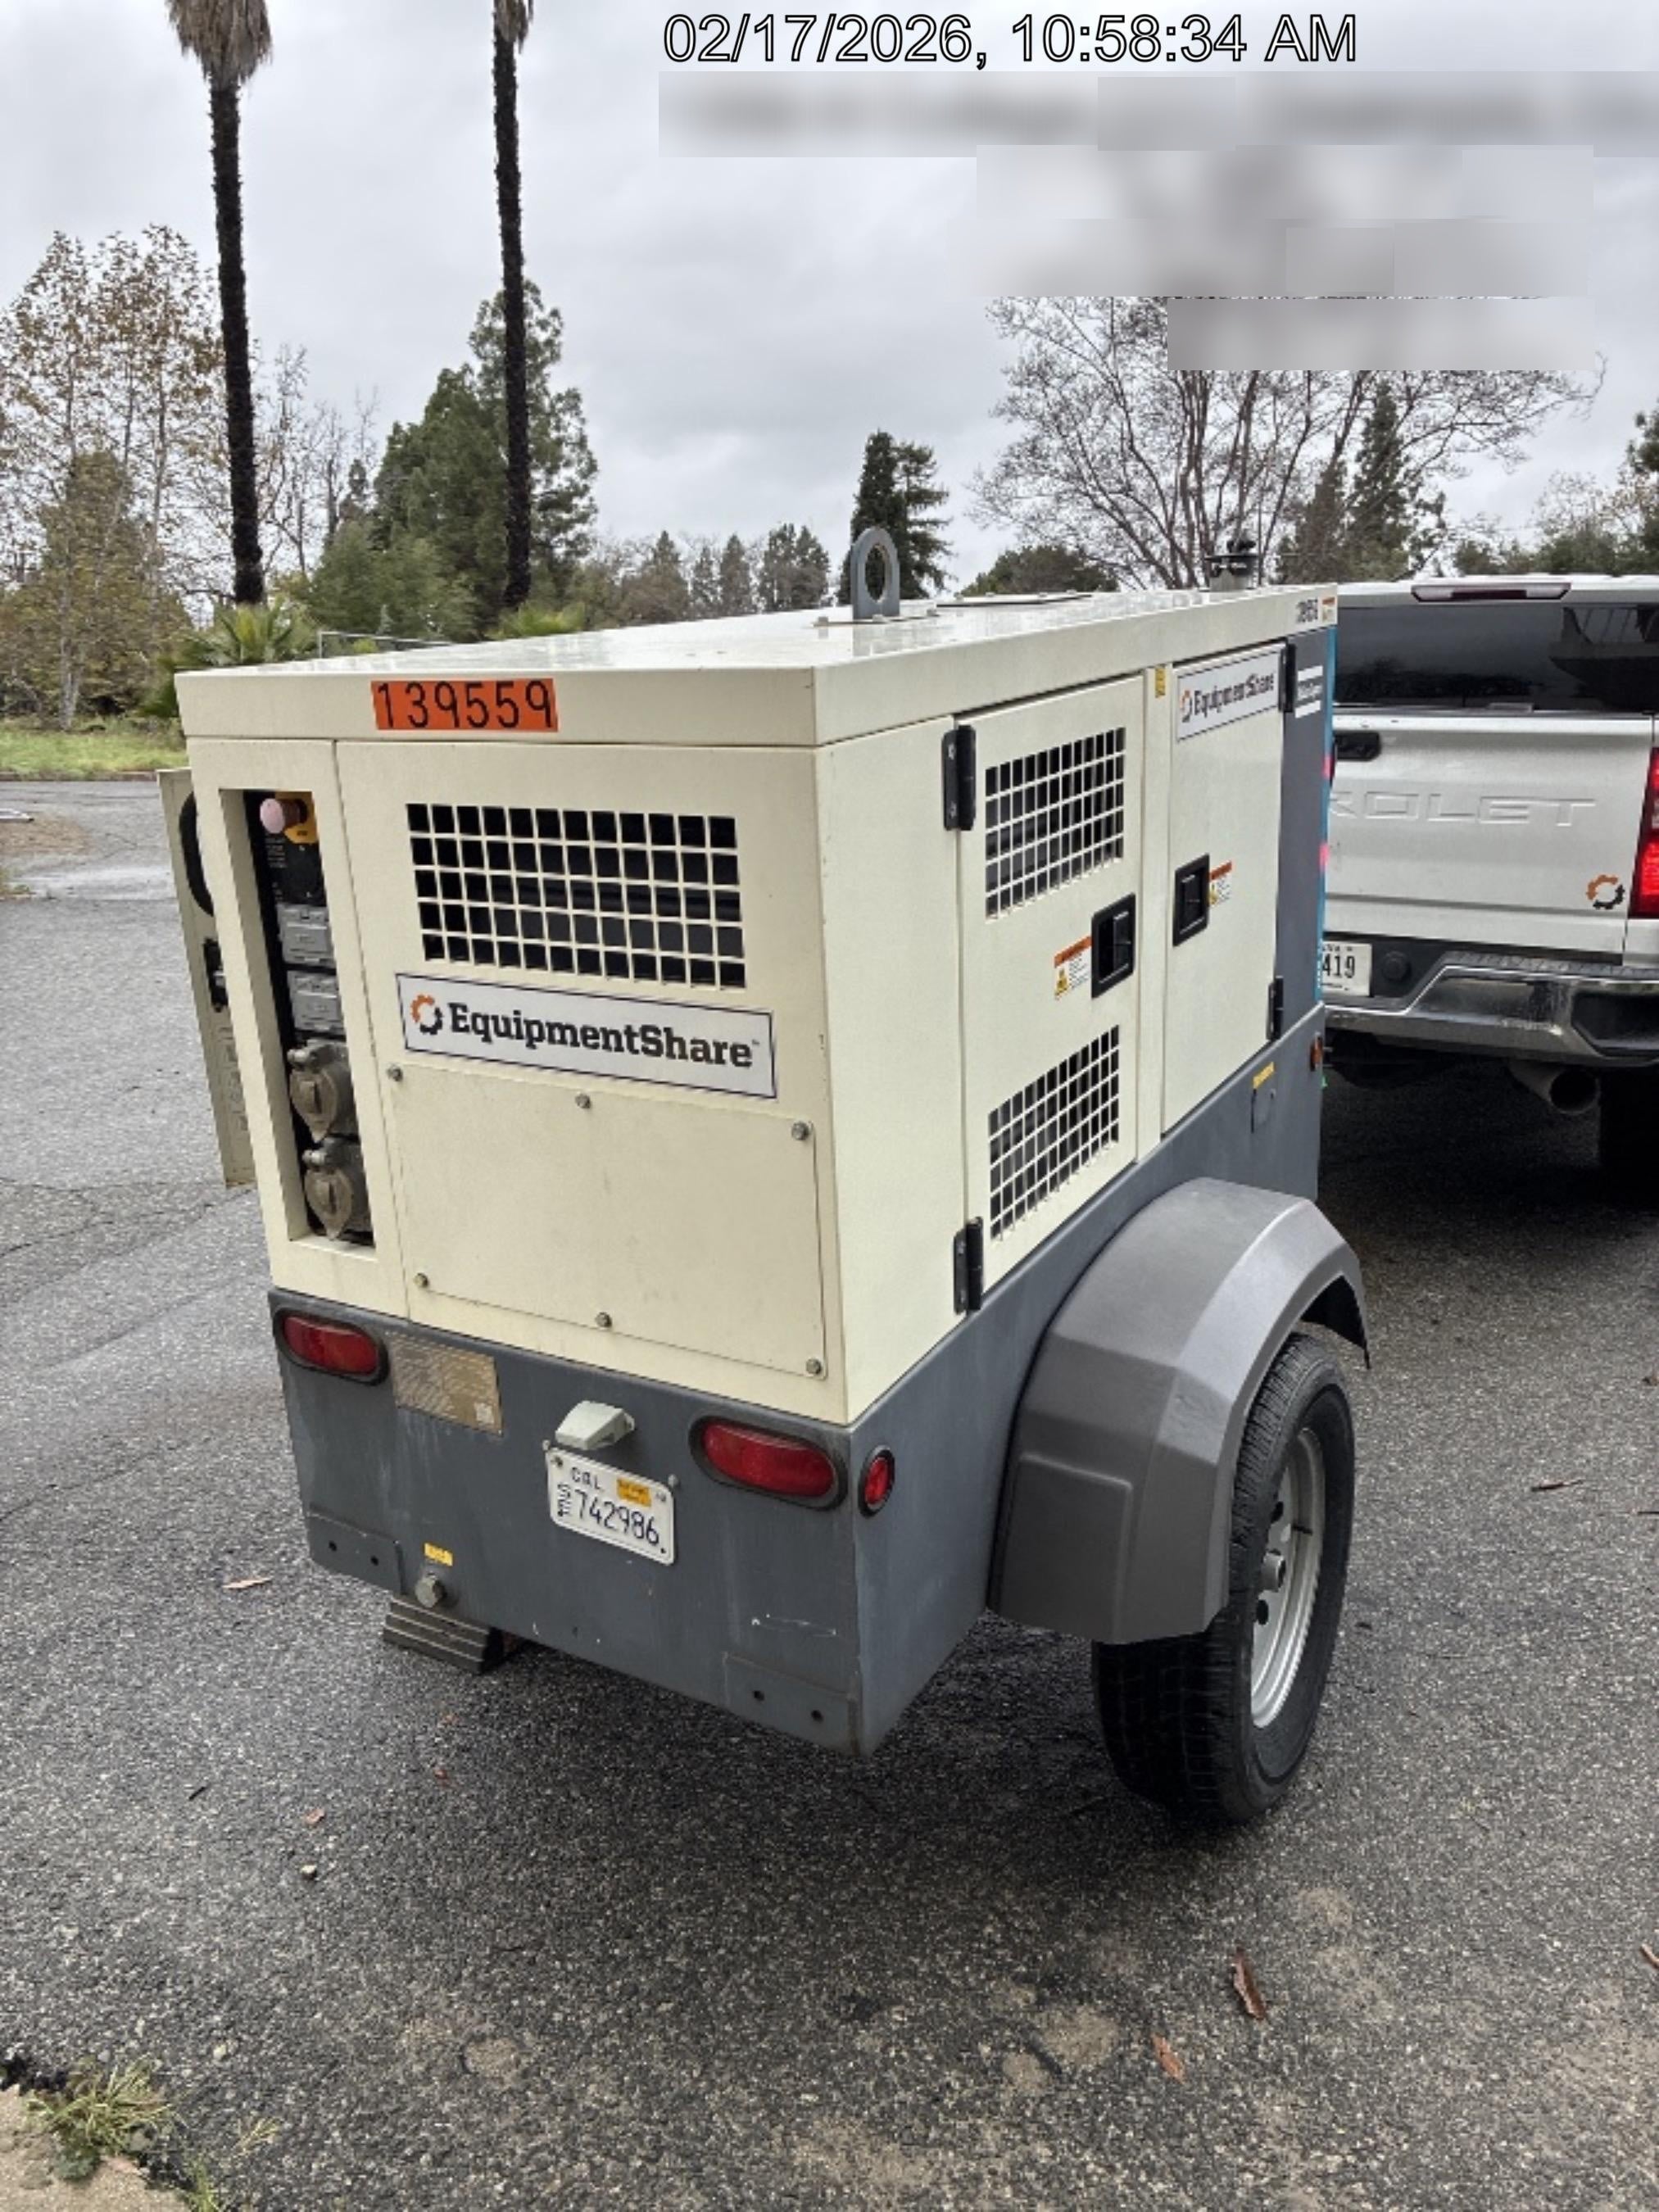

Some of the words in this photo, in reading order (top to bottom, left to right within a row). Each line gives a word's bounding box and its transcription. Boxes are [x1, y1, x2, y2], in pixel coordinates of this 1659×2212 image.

[377, 679, 554, 728] 139559
[1328, 791, 1597, 827] ROLET
[1321, 953, 1356, 979] 419
[448, 1001, 754, 1068] EquipmentShare
[574, 1488, 660, 1545] 742986
